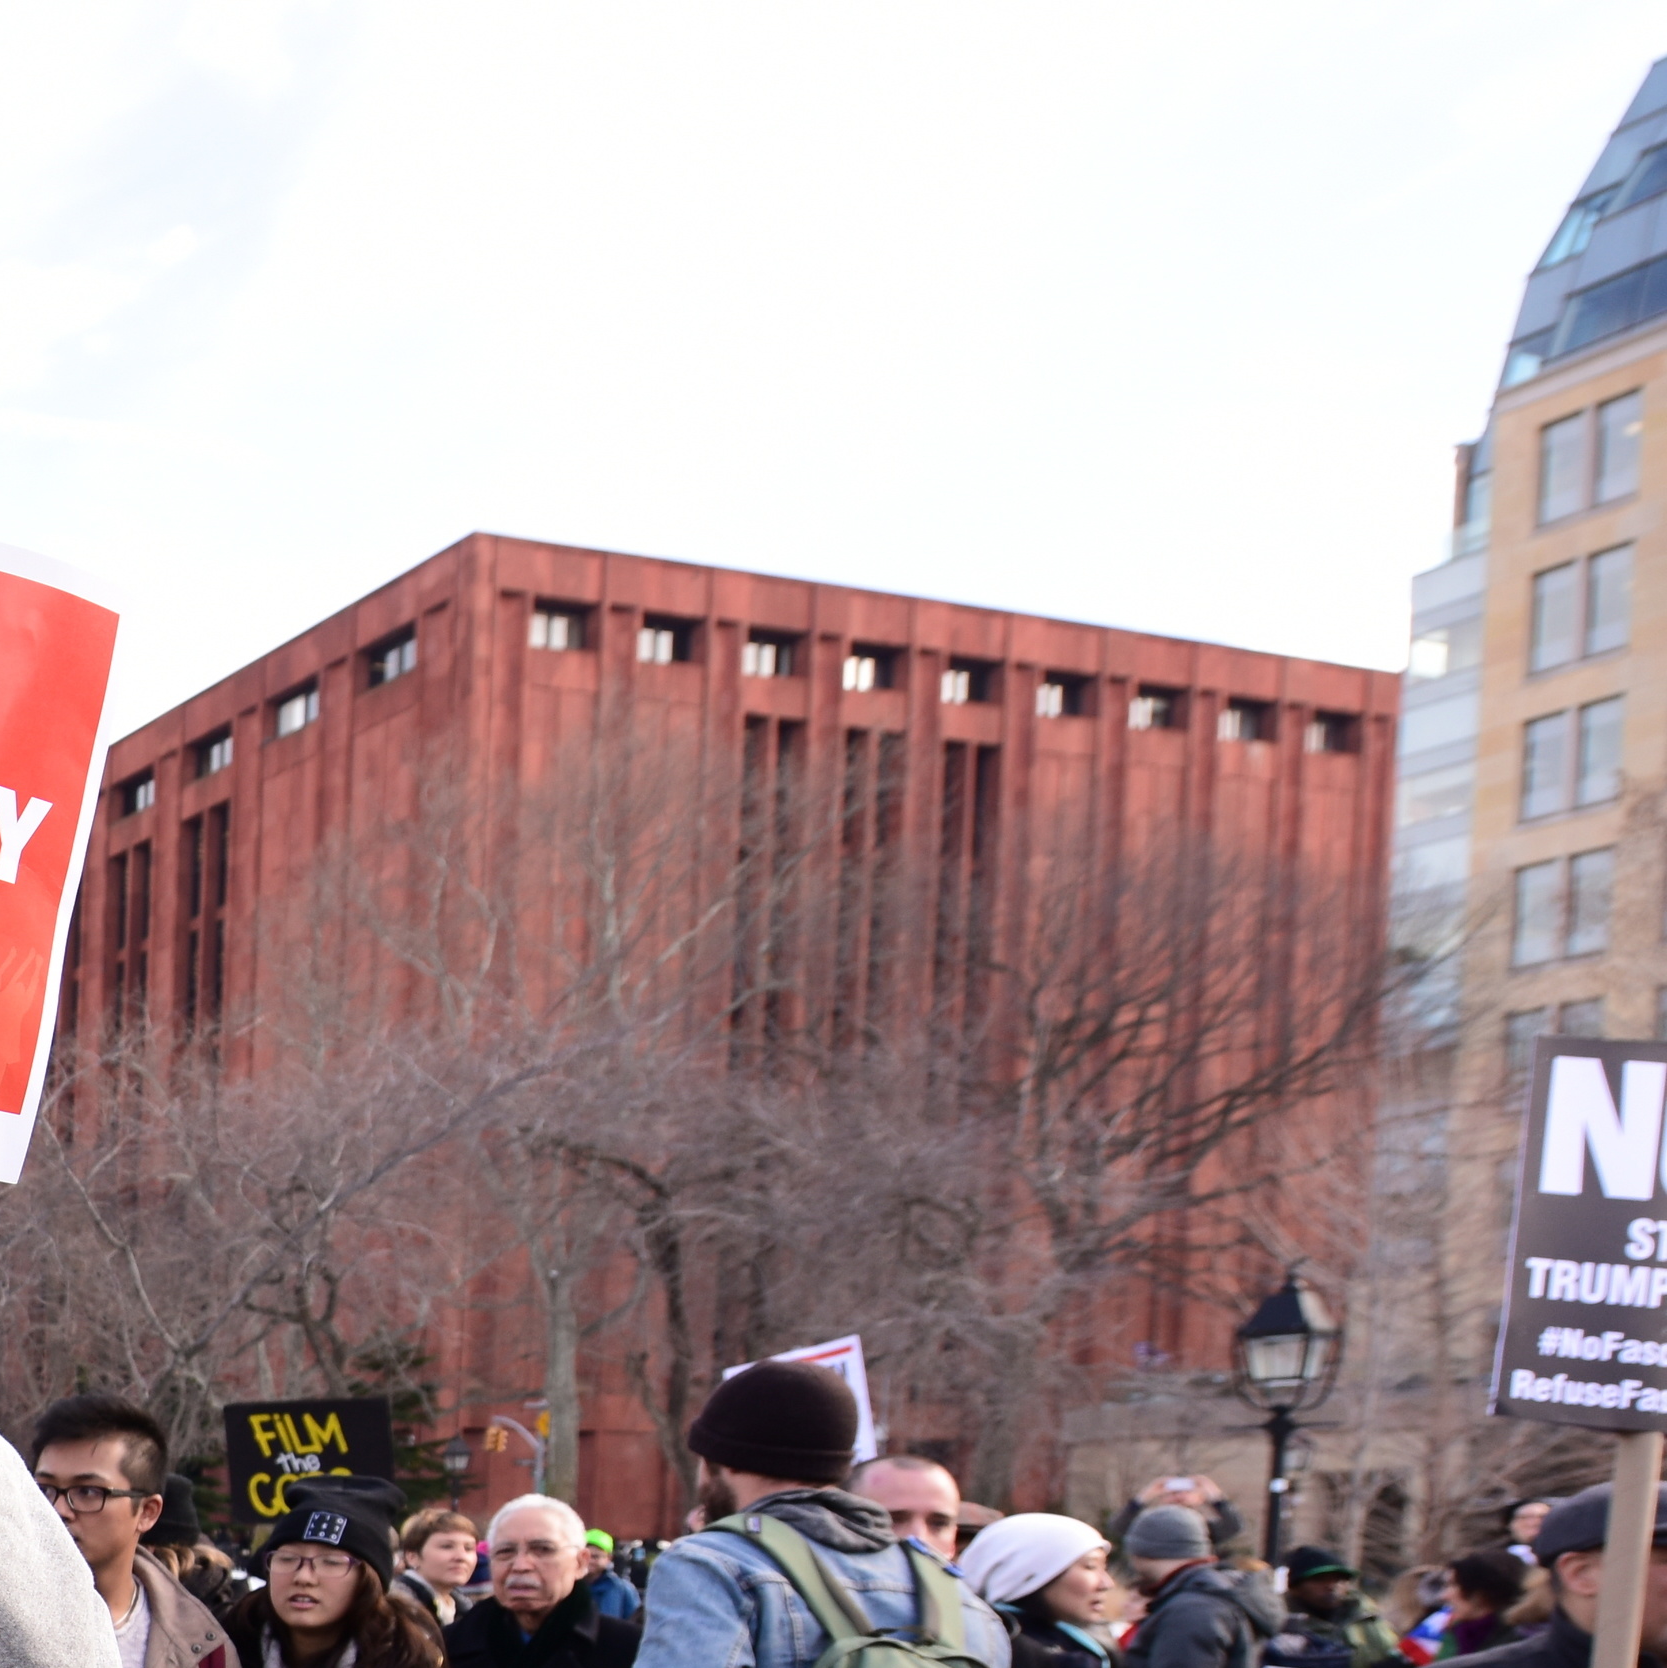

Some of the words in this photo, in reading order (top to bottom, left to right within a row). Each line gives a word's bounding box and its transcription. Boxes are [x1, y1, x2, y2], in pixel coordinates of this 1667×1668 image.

[1538, 1055, 1667, 1201] N
[1525, 1257, 1667, 1308] TRUMP
[275, 1452, 321, 1474] the
[248, 1467, 353, 1518] CO
